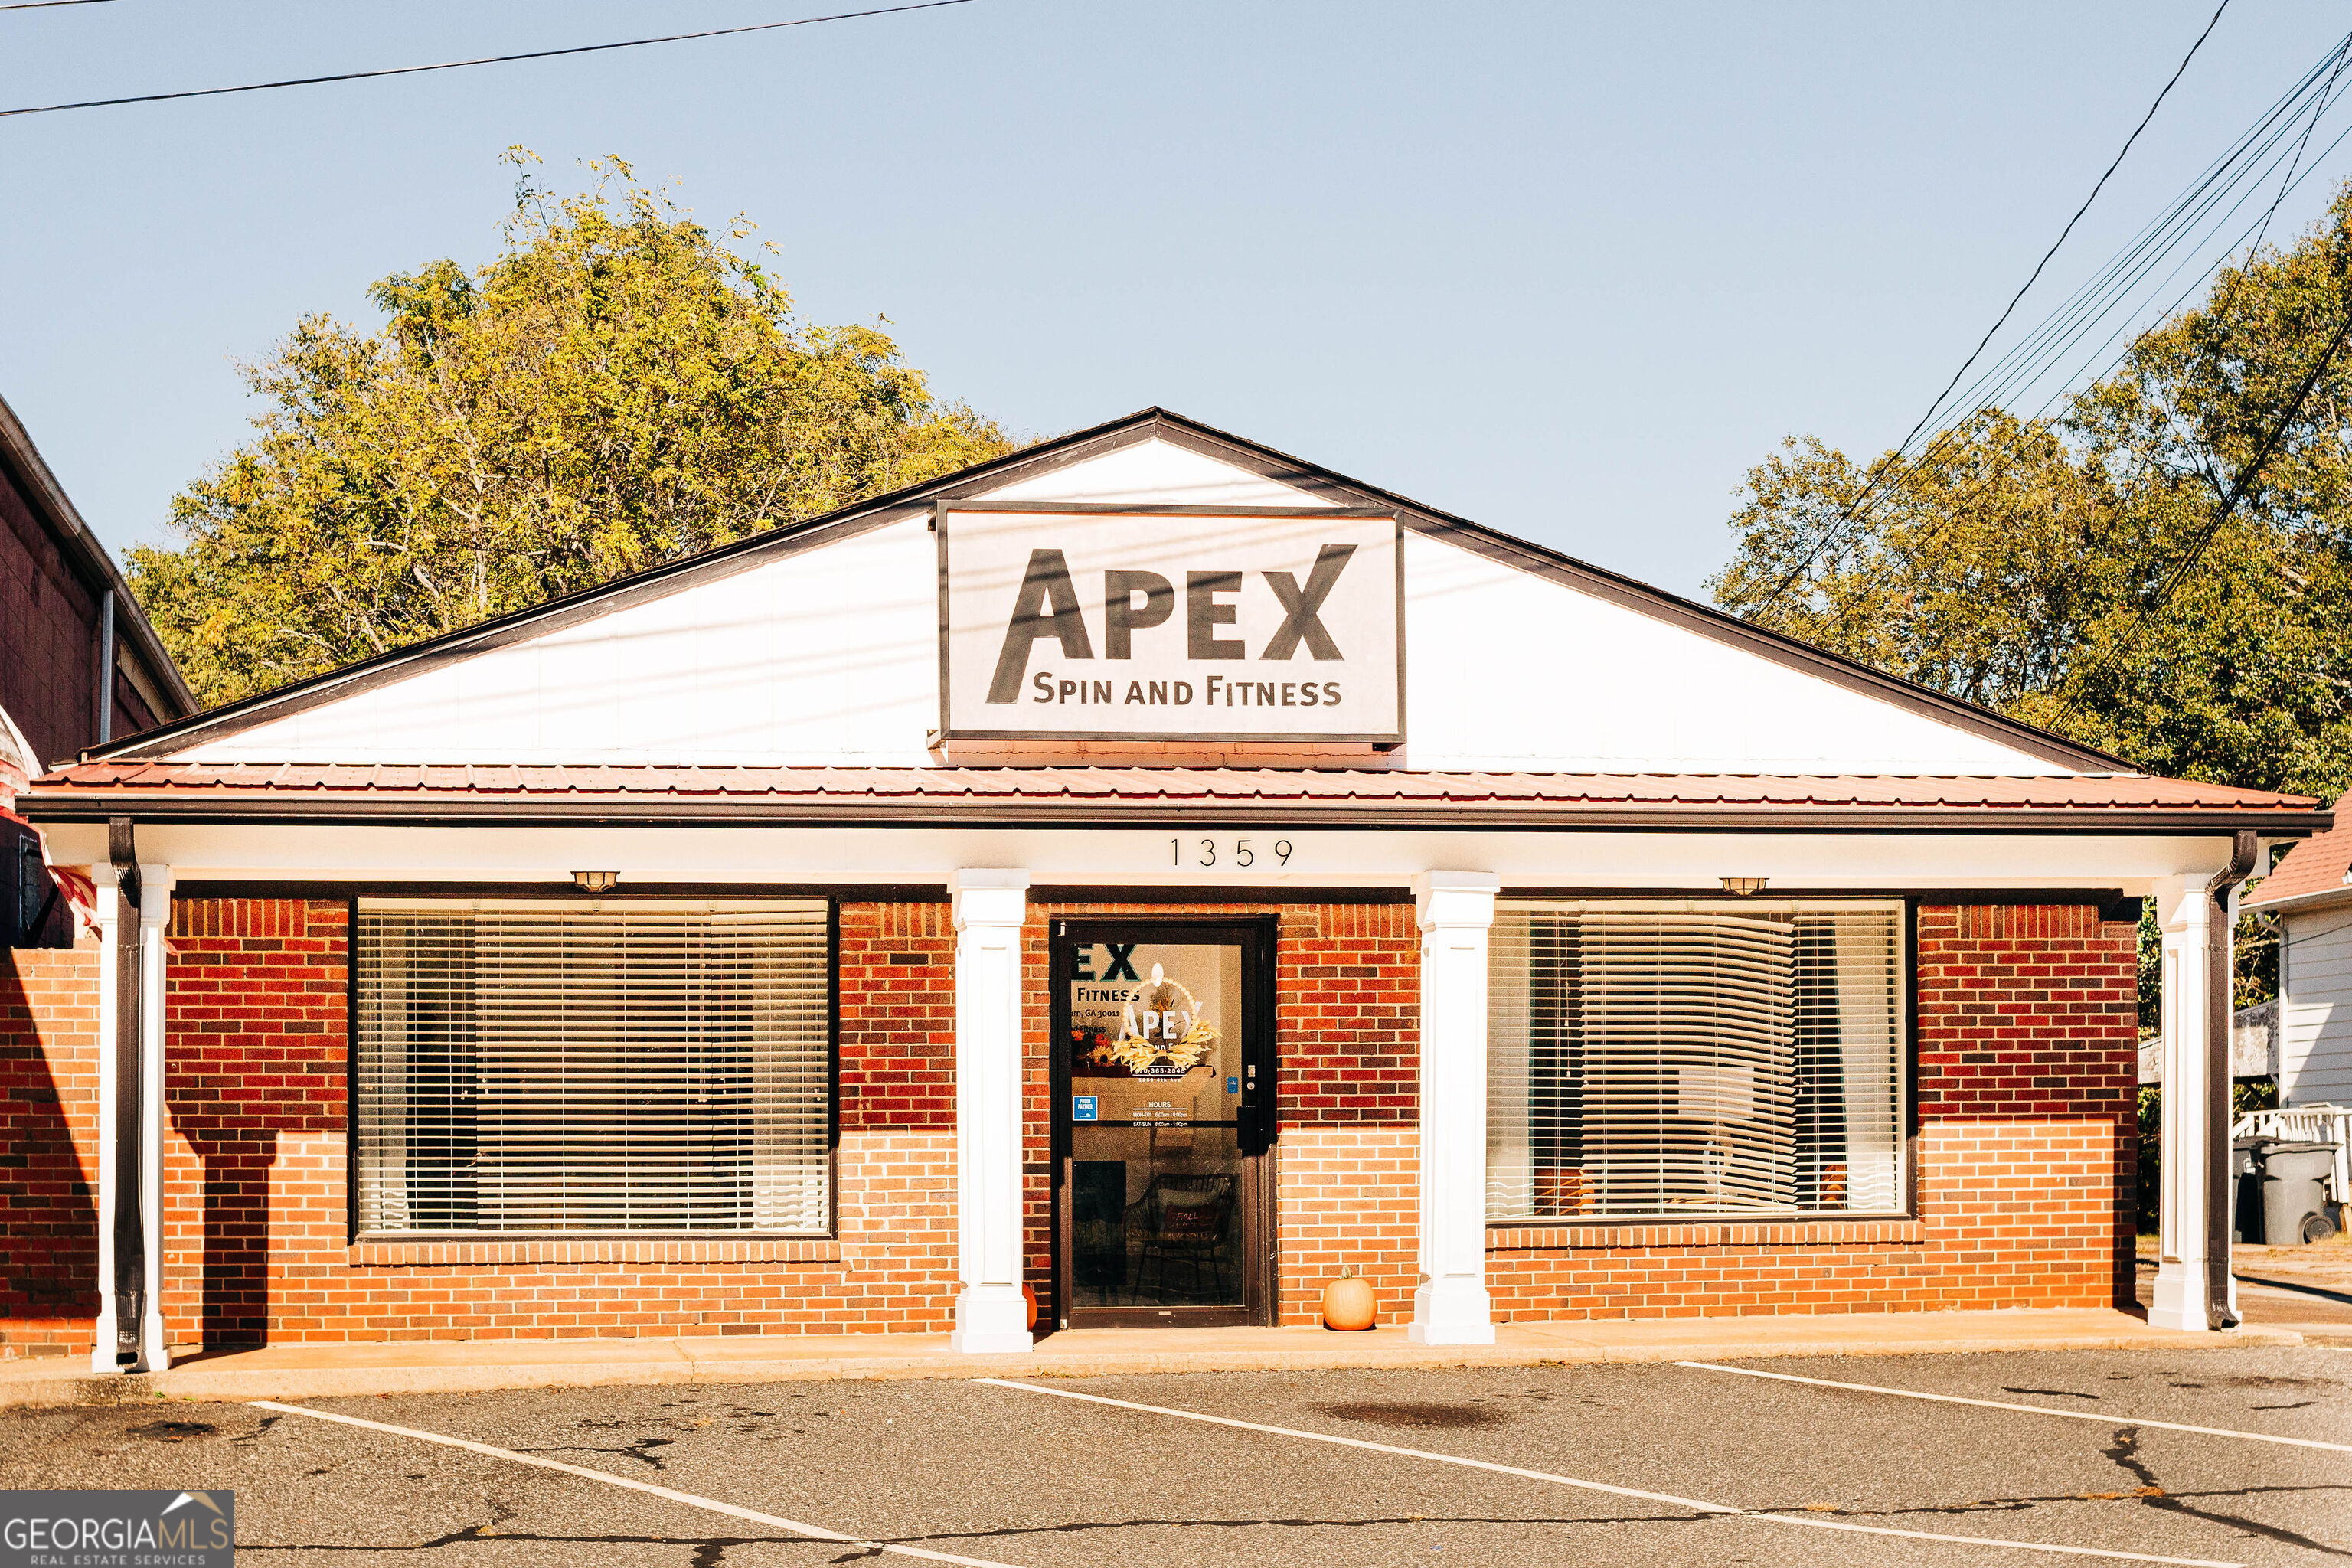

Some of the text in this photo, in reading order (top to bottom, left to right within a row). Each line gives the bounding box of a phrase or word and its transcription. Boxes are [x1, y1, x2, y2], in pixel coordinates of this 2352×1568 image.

[986, 544, 1358, 704] APEX
[1033, 671, 1342, 707] SPIN AND FITNESS
[1171, 838, 1293, 867] 1359
[1077, 987, 1140, 1001] FITNESS
[1176, 1212, 1199, 1220] FALL
